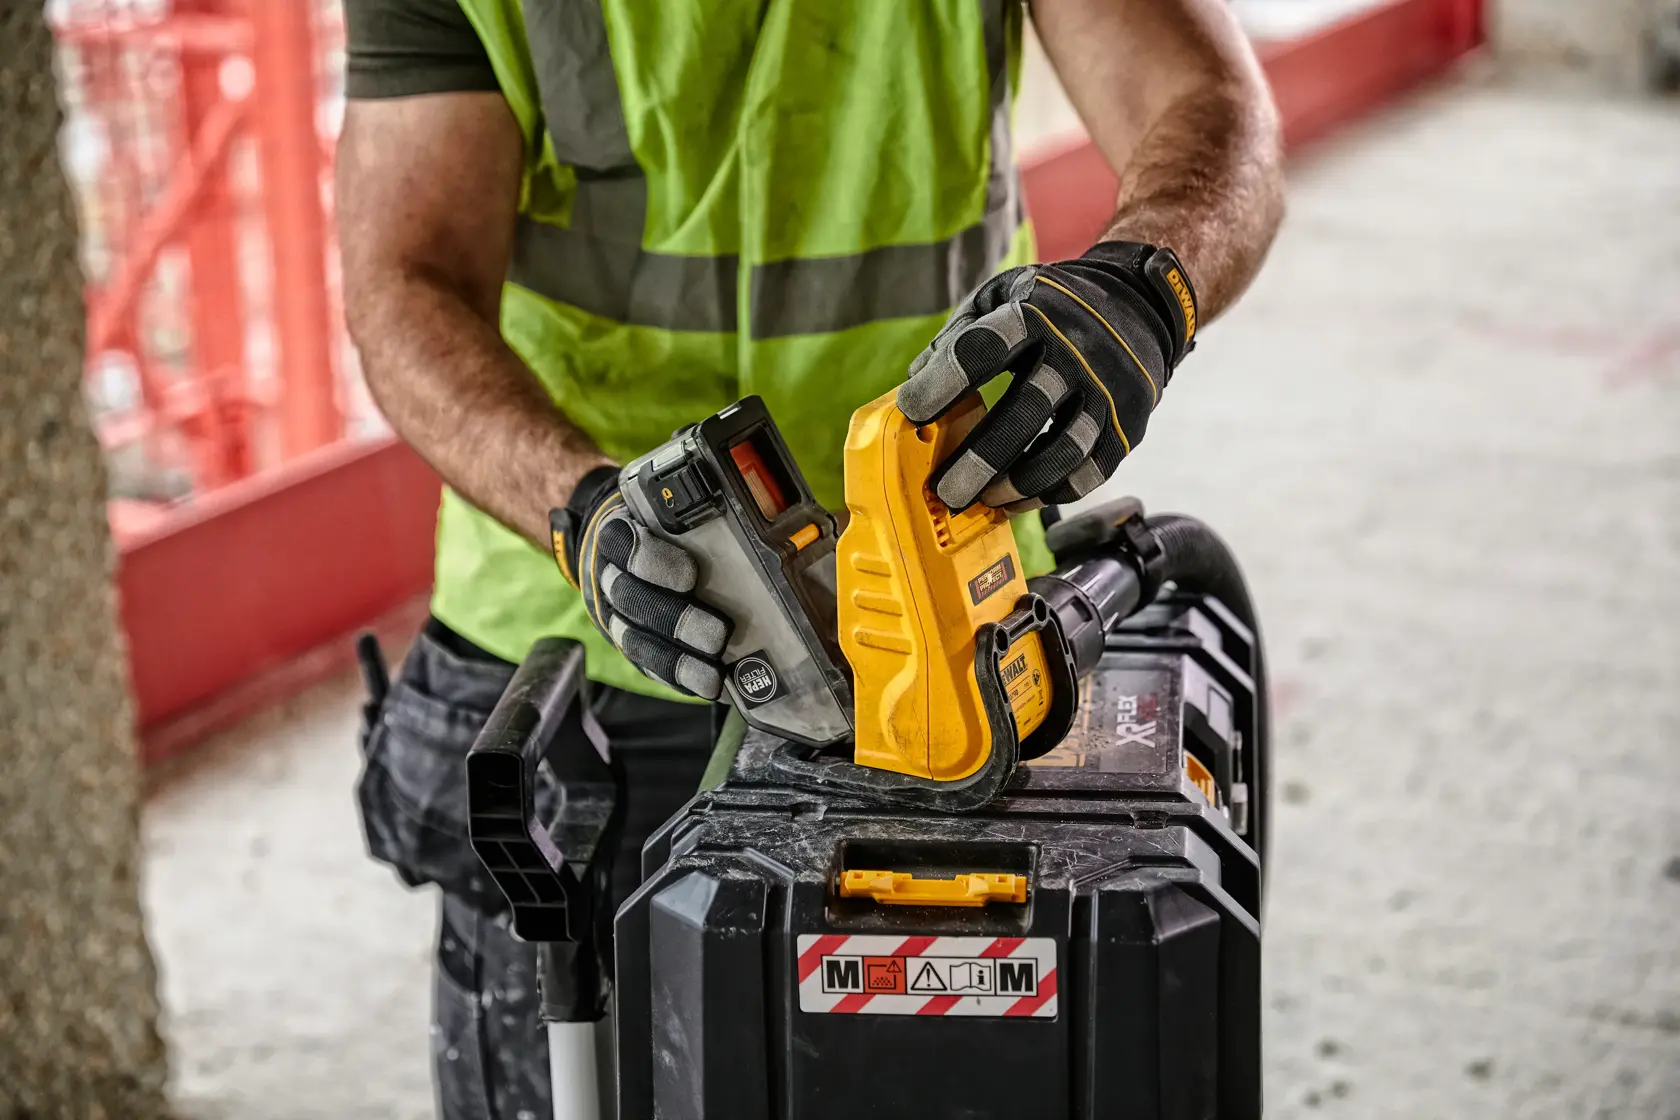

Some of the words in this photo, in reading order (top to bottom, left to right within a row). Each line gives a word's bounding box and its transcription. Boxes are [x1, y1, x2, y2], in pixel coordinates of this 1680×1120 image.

[739, 666, 766, 683] FILTER
[744, 675, 772, 694] HEPA
[1001, 655, 1025, 685] EWALT
[825, 960, 860, 989] M
[999, 963, 1034, 992] M
